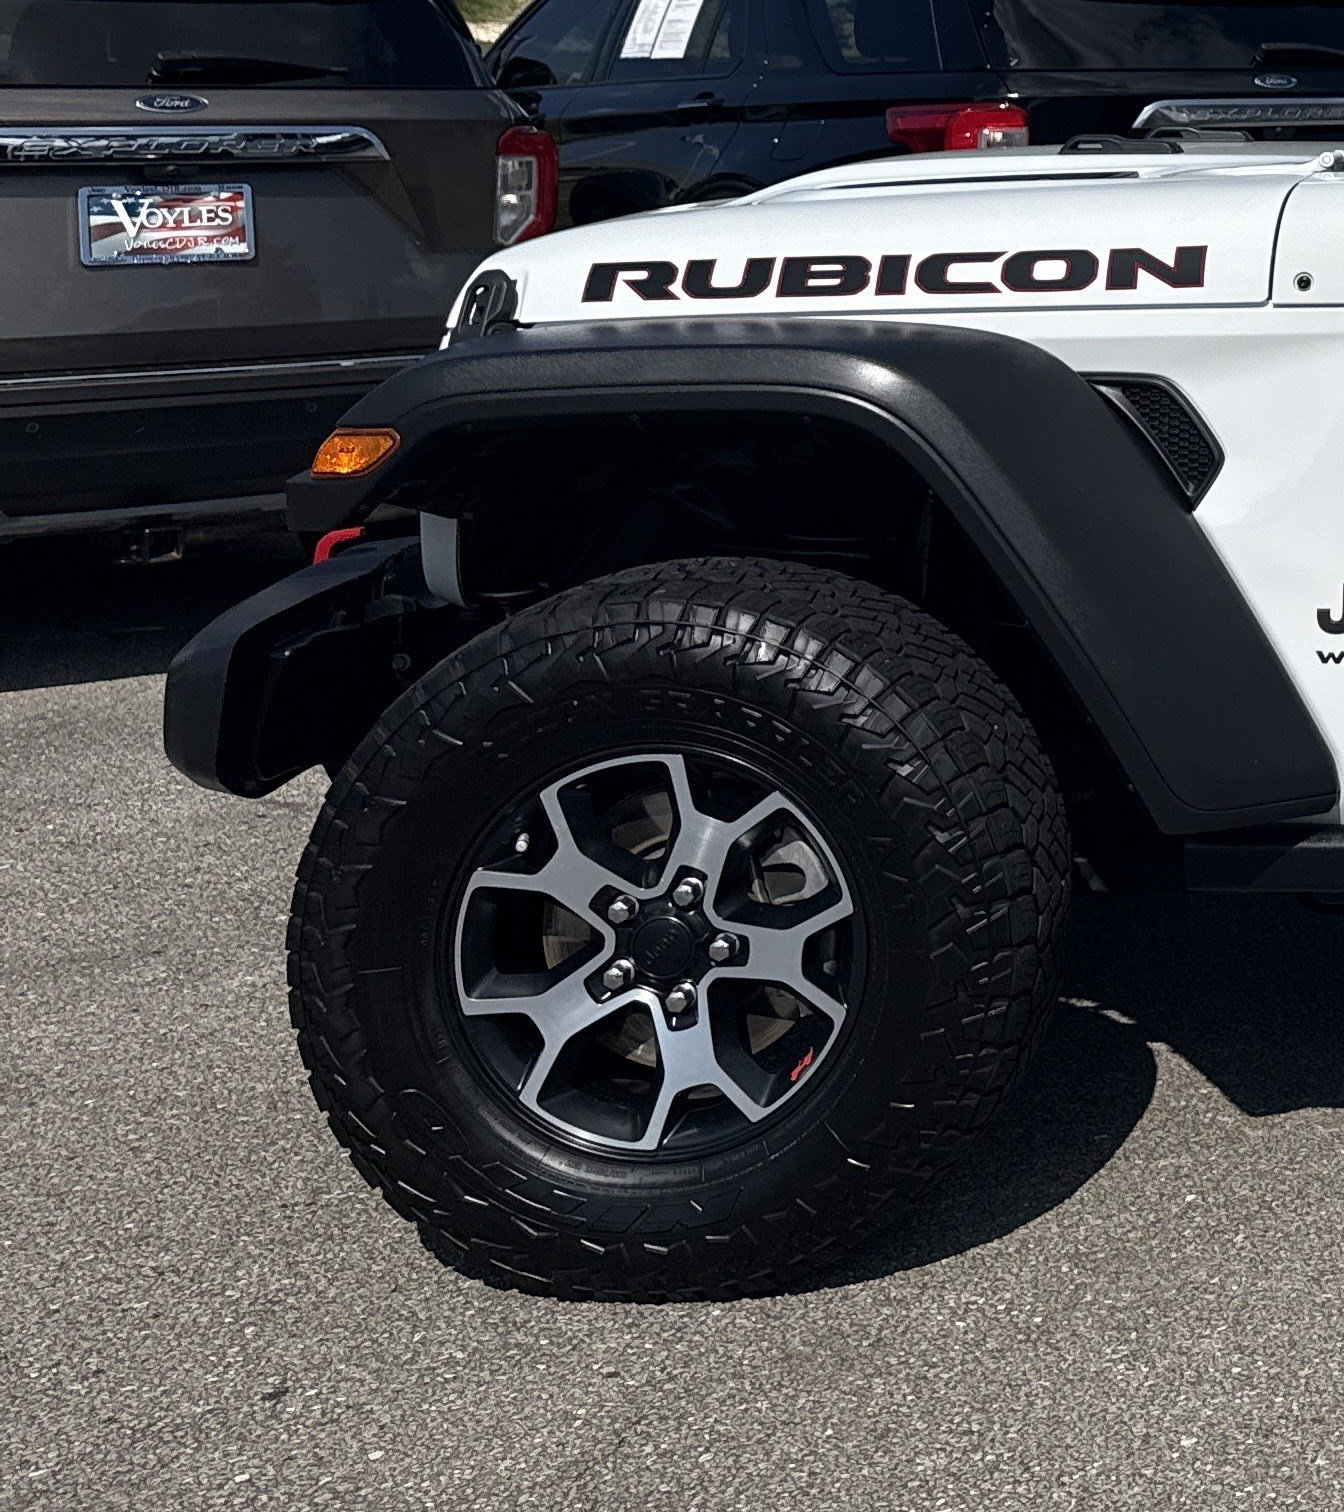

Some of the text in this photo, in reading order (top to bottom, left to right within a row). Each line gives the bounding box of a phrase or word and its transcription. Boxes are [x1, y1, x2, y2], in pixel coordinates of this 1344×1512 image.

[153, 96, 191, 108] Ford
[111, 199, 233, 238] VOYLES
[581, 245, 1209, 303] RUBICON
